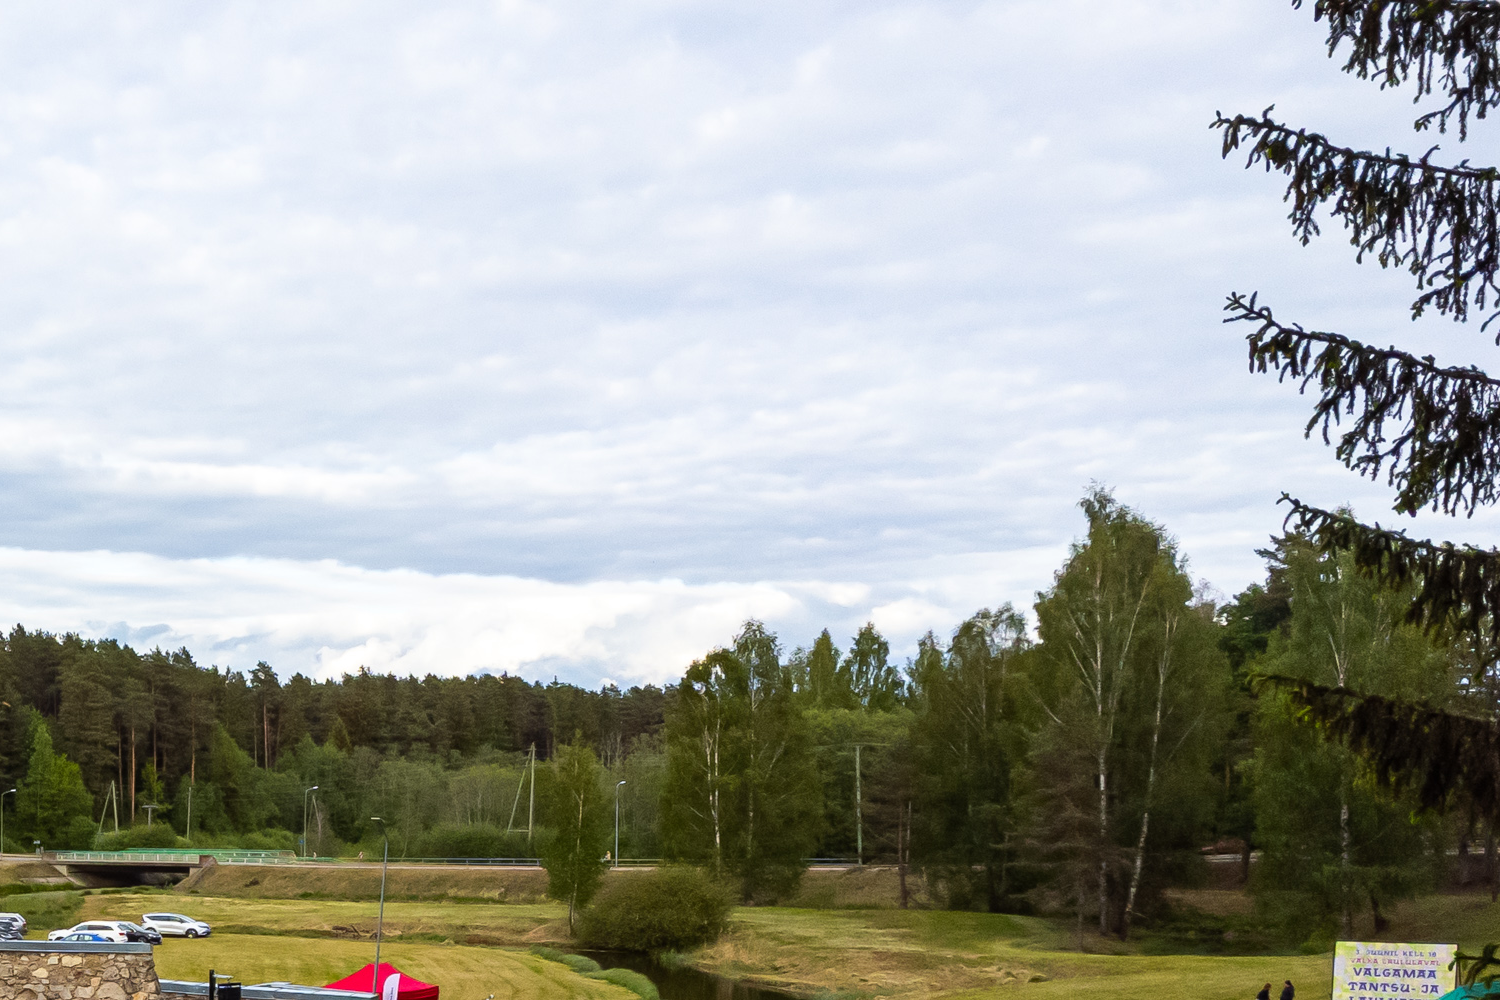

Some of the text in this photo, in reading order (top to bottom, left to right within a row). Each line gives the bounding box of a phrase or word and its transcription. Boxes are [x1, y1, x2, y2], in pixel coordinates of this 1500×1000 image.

[1353, 967, 1437, 979] VALGAMAA
[1348, 982, 1439, 994] TANTSU- JA
